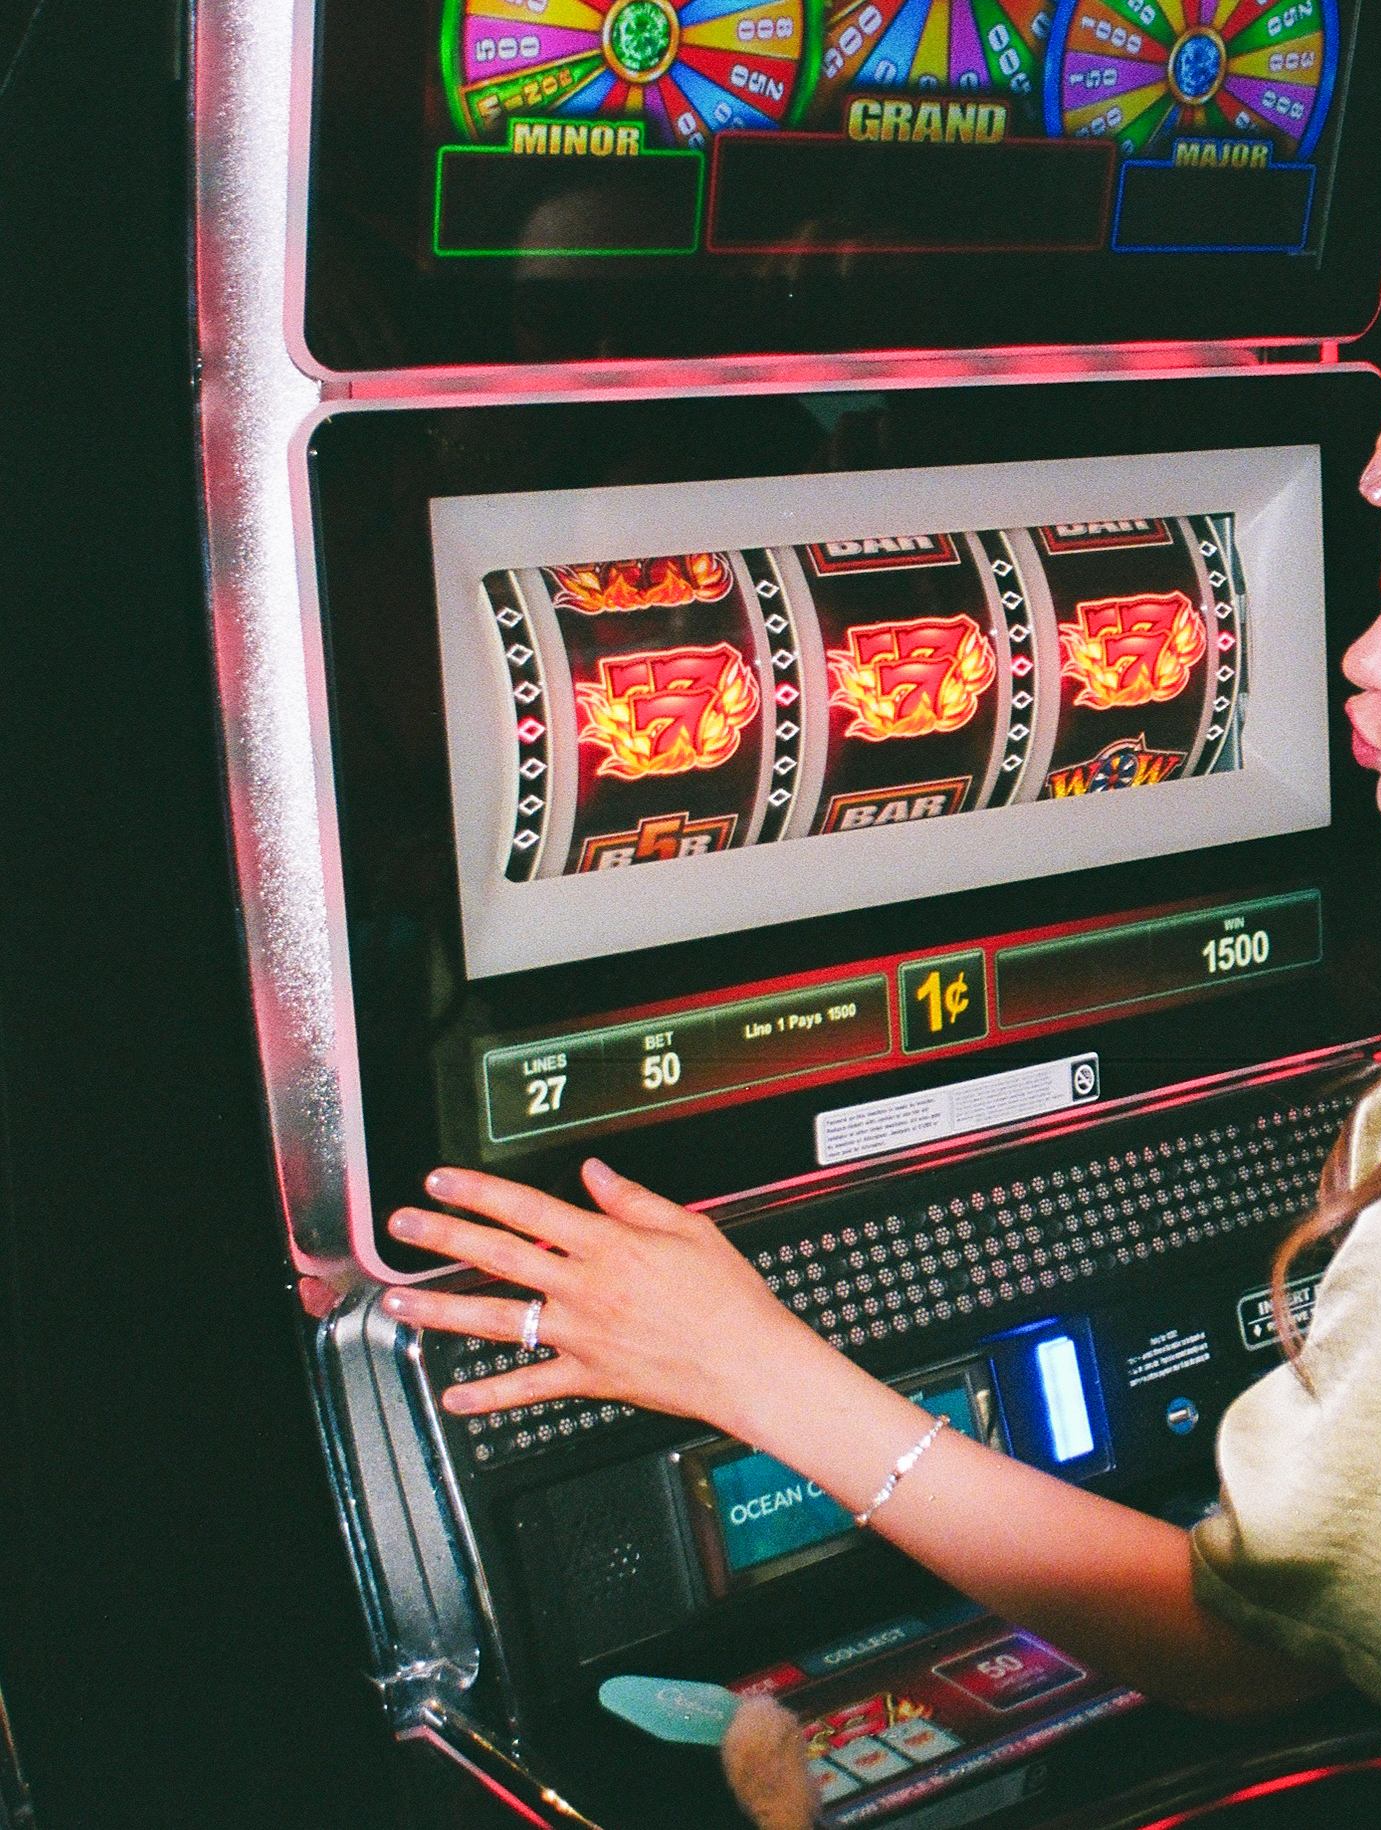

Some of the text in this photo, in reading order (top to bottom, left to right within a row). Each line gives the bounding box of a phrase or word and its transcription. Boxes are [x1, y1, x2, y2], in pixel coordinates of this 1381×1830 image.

[475, 36, 541, 62] 500
[730, 64, 785, 101] 250
[512, 122, 640, 157] MINOR
[848, 99, 1007, 144] GRAND
[1174, 142, 1270, 169] MAJOR
[838, 793, 948, 832] BAR
[1223, 916, 1246, 932] WIN
[1202, 930, 1269, 973] 1500
[914, 970, 970, 1032] 1¢
[745, 1020, 773, 1039] Line
[788, 1011, 823, 1030] Pays
[828, 1002, 857, 1023] 1500
[643, 1029, 674, 1051] BET
[522, 1053, 568, 1076] LINES
[641, 1050, 682, 1090] 50
[525, 1075, 568, 1115] 27
[729, 1483, 803, 1526] OCEAN
[976, 1653, 1025, 1679] 50
